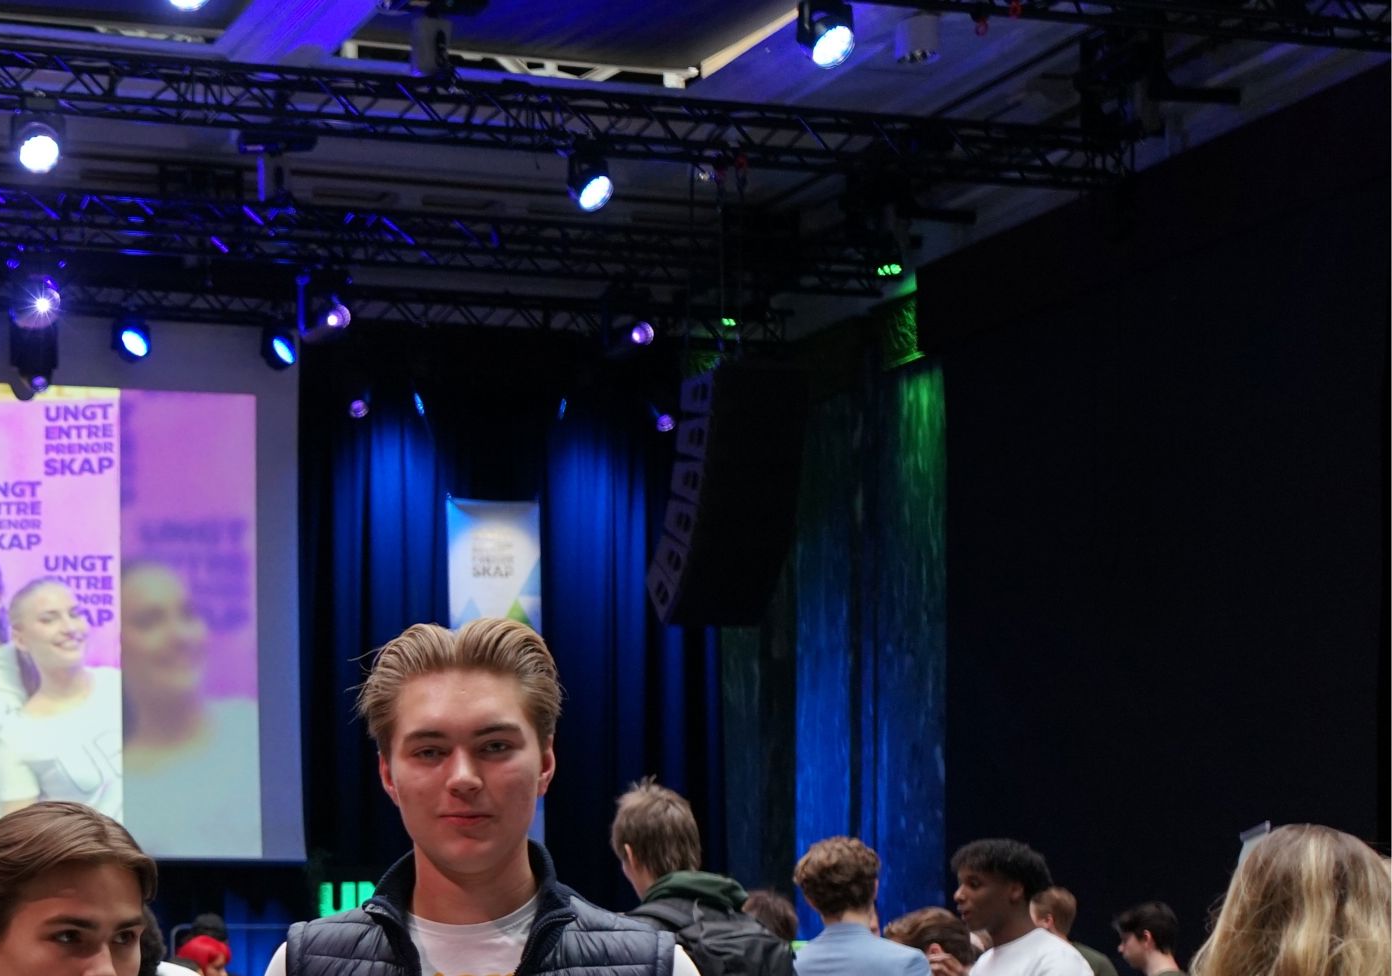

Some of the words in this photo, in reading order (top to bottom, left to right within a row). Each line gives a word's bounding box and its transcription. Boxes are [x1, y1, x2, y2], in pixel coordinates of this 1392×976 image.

[45, 403, 113, 422] UNGT
[45, 423, 113, 440] ENTRE
[44, 457, 114, 476] SKAP
[44, 555, 113, 572] UNGT
[57, 575, 113, 590] NTRE
